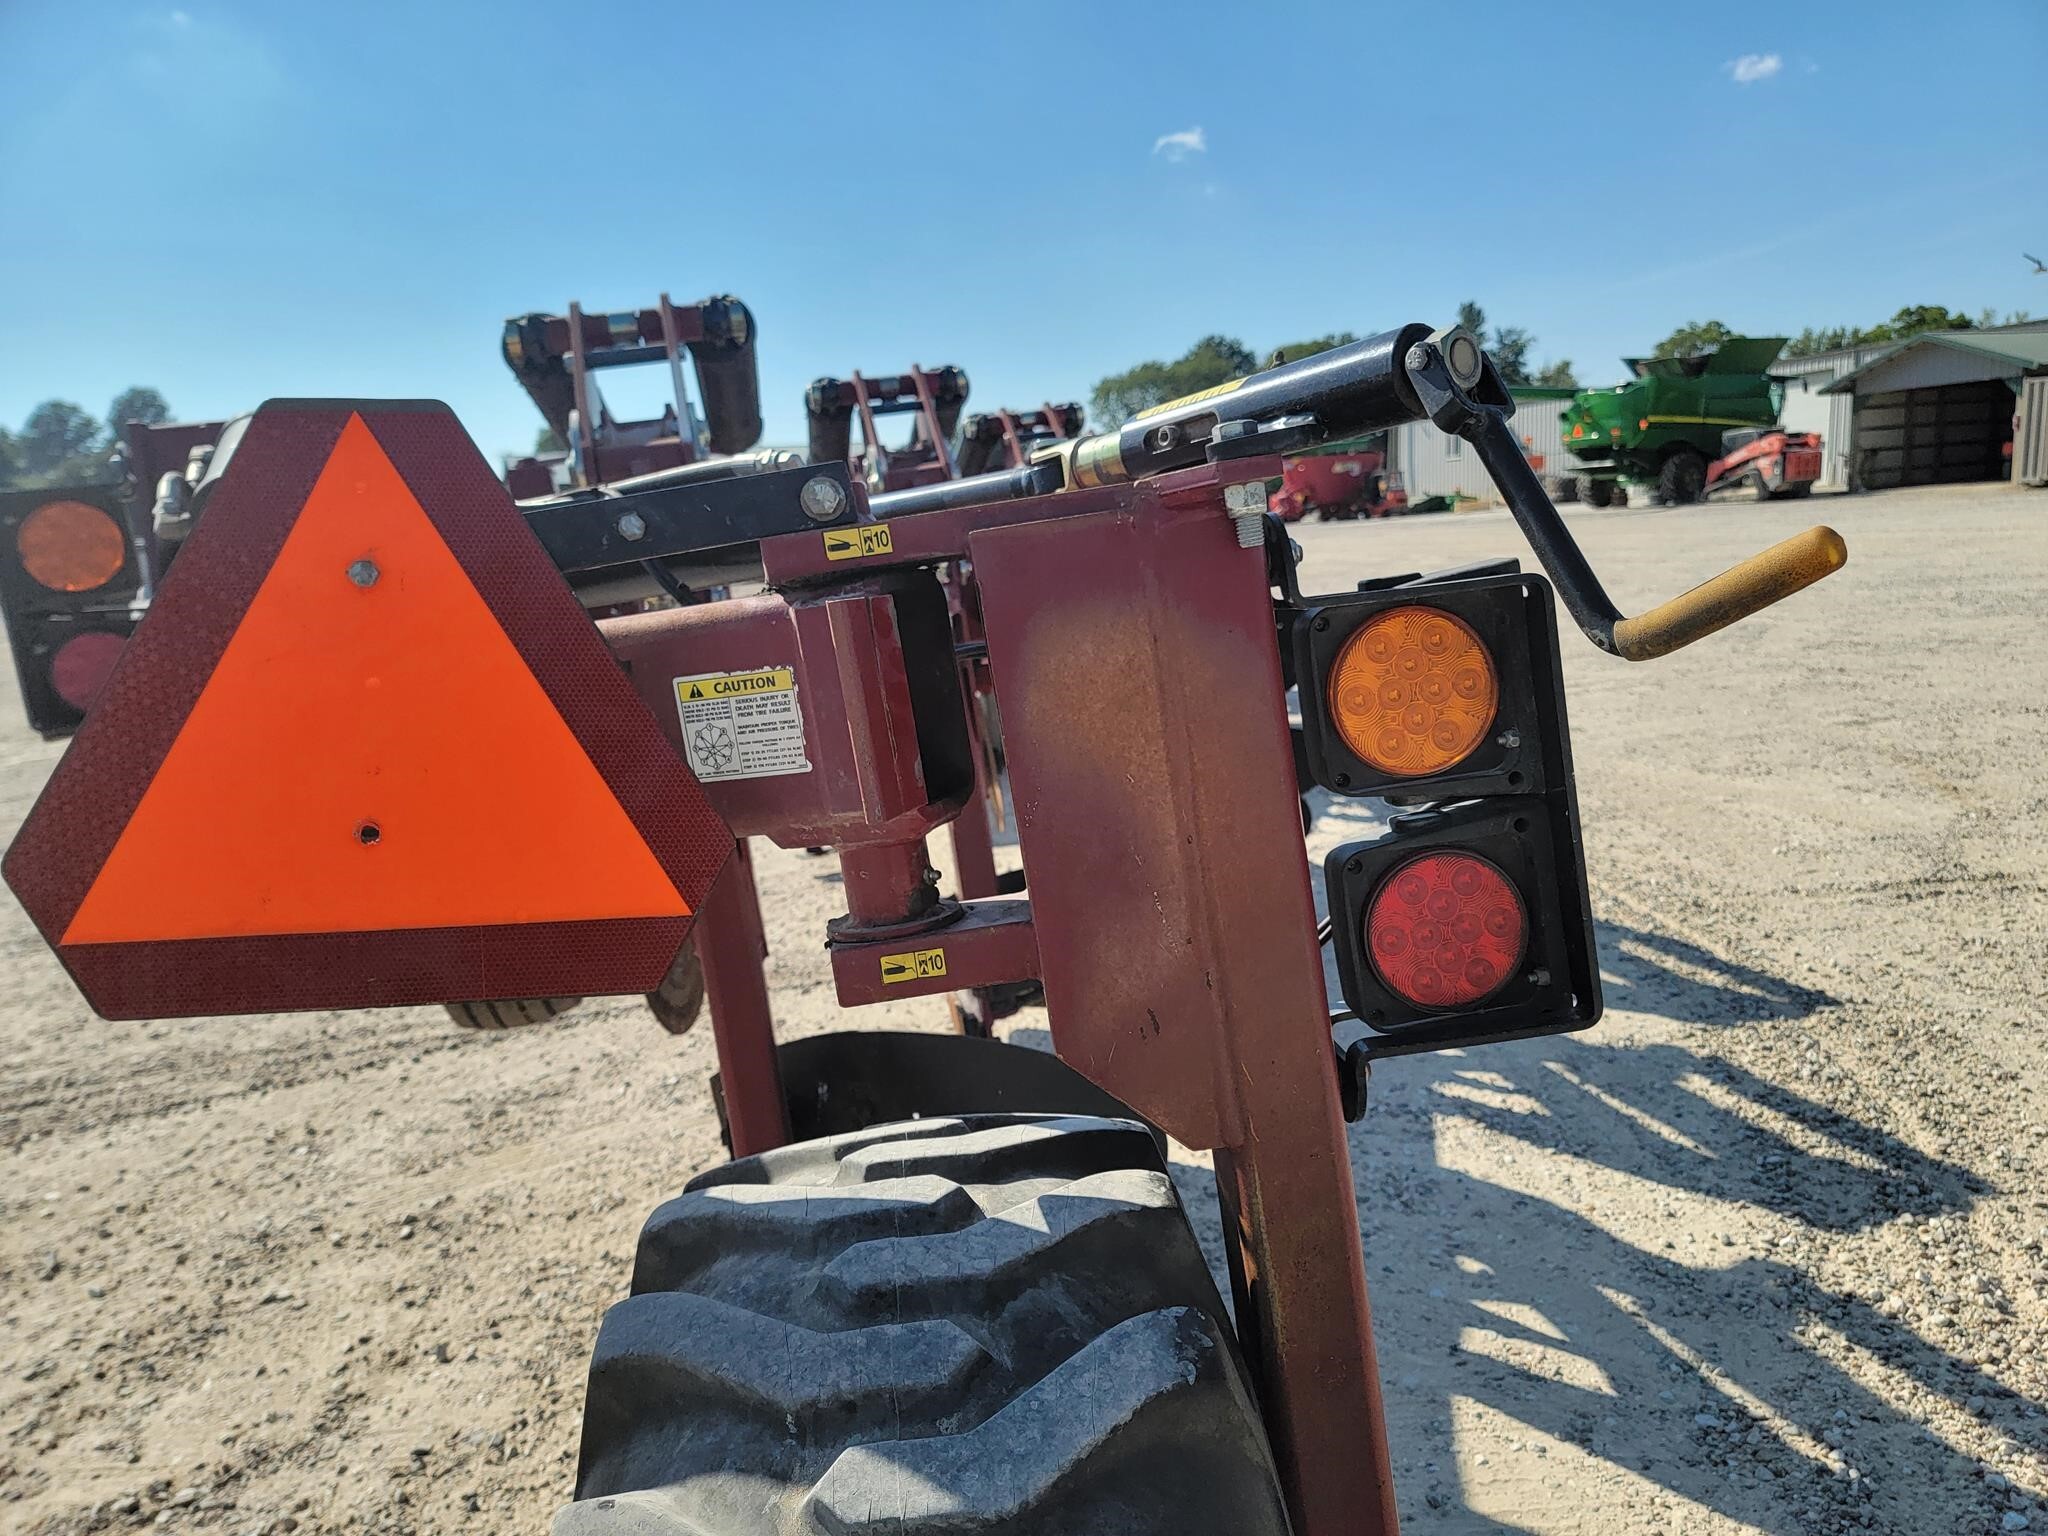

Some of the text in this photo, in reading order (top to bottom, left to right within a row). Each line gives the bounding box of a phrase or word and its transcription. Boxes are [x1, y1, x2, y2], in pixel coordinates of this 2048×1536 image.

[873, 530, 889, 548] 10
[714, 676, 776, 694] CAUTION
[928, 954, 943, 971] 10
